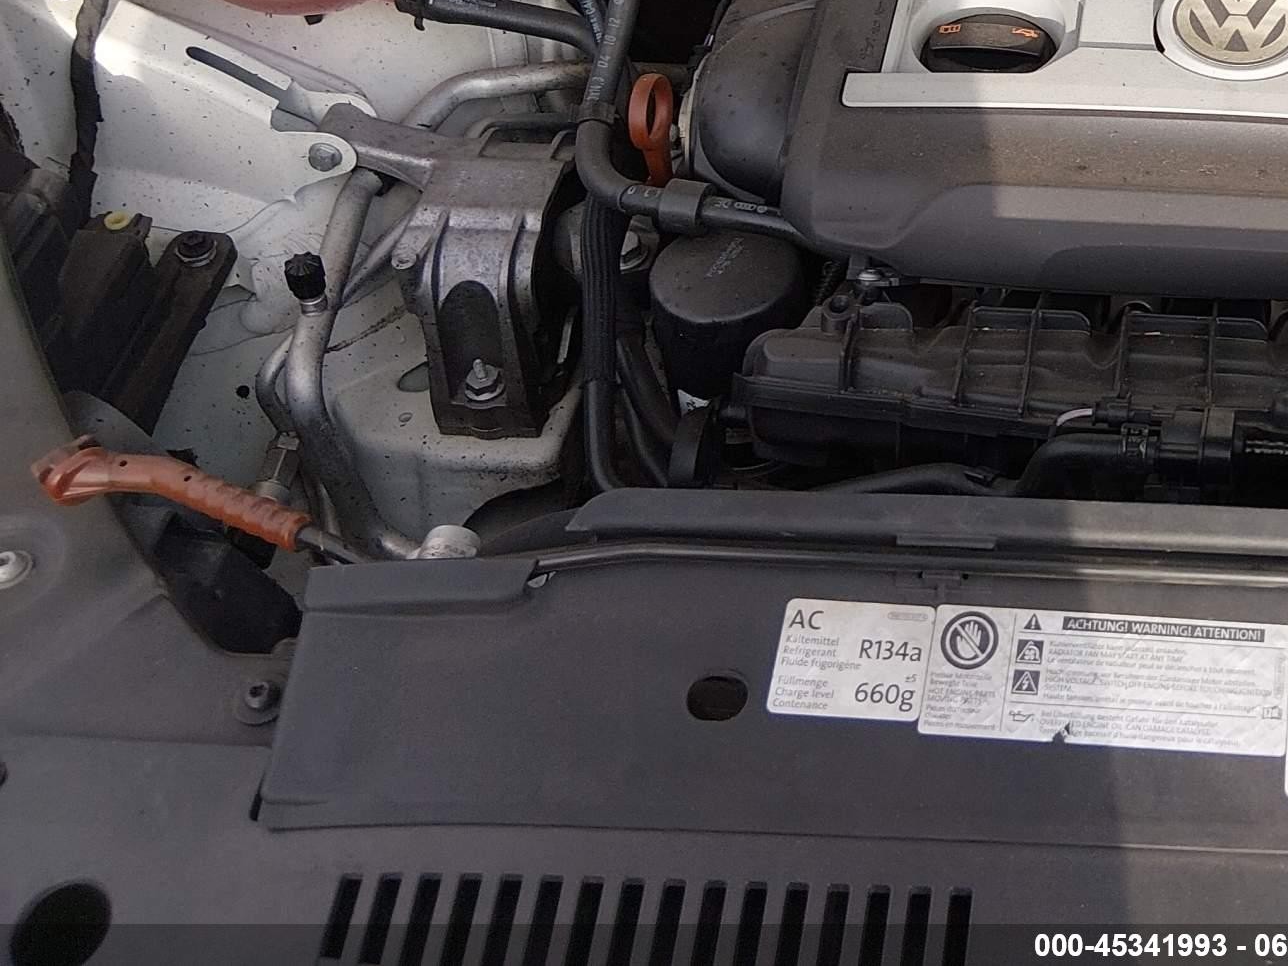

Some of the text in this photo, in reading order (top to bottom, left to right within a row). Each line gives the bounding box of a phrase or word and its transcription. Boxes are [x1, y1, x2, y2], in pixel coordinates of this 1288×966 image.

[788, 609, 825, 630] AC
[1067, 619, 1262, 640] ACHTUNG! WARNING! ATTENTION!
[783, 645, 837, 658] Refrigerant
[859, 639, 923, 662] R134a
[780, 657, 809, 667] Fluide
[775, 687, 835, 699] Charge level
[854, 682, 916, 713] 660g
[772, 698, 829, 711] Contenance
